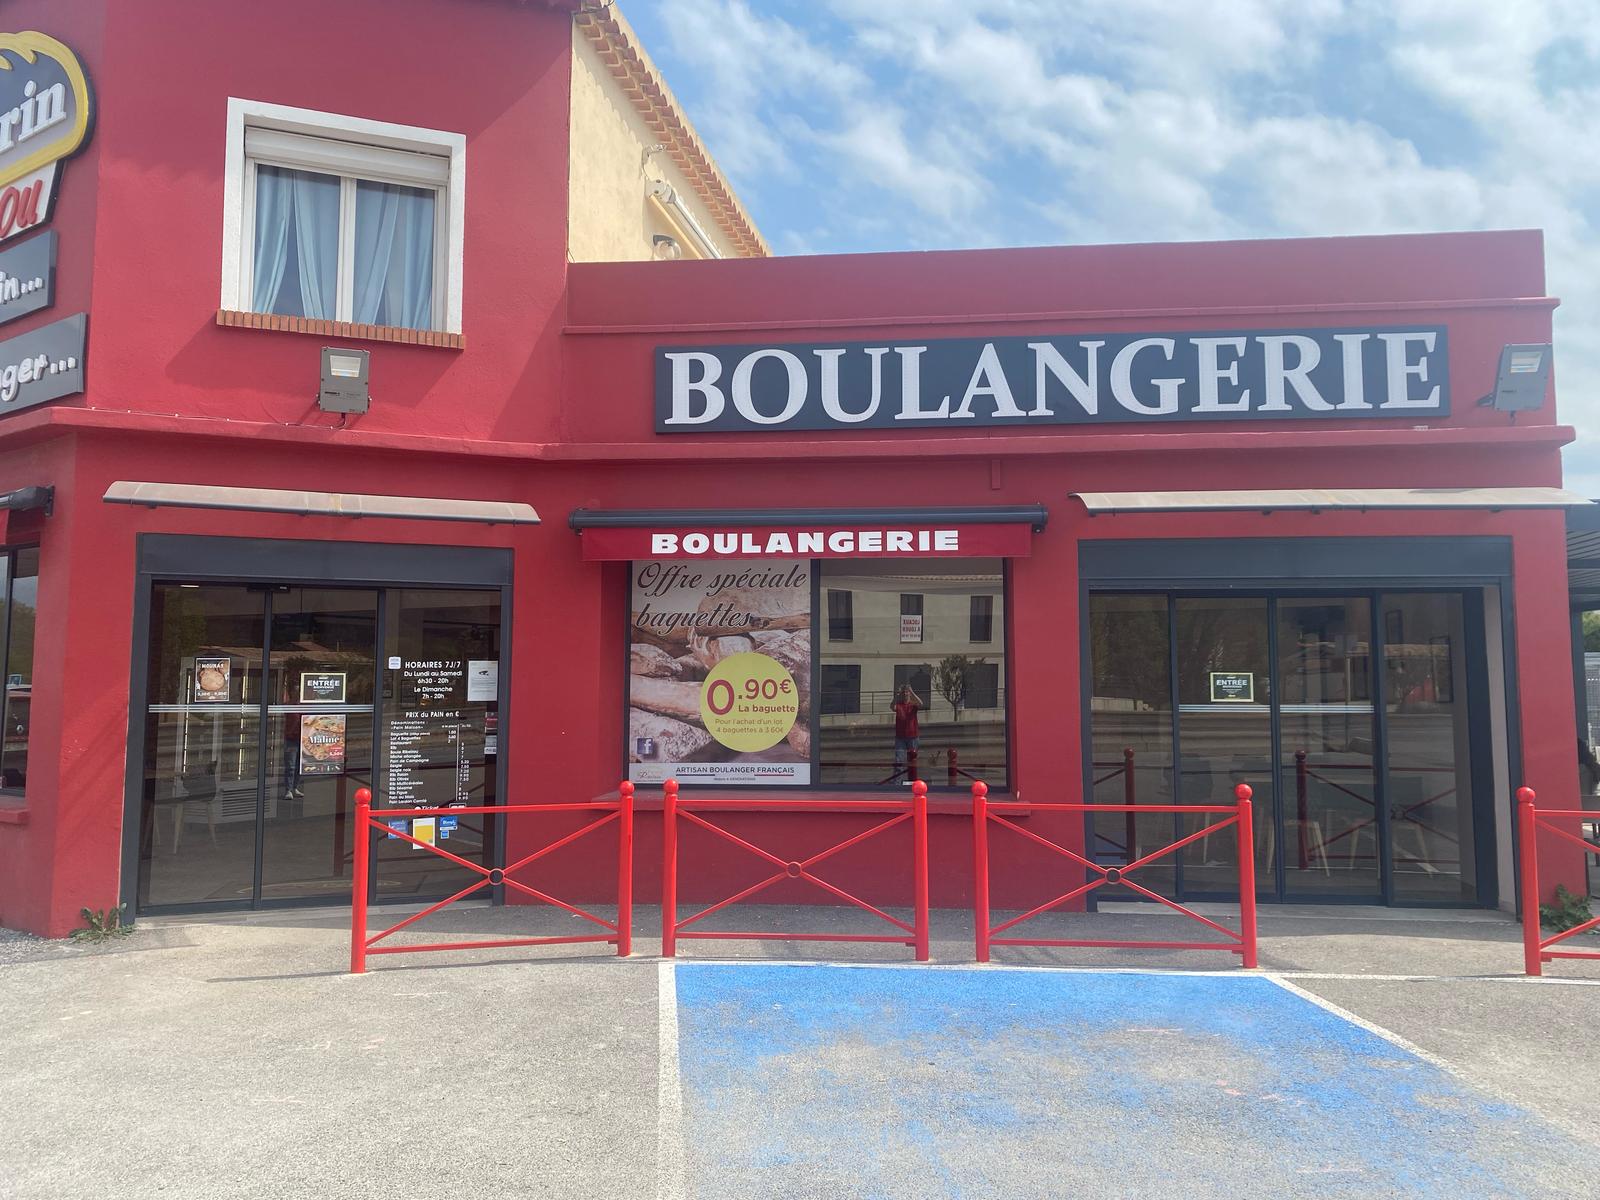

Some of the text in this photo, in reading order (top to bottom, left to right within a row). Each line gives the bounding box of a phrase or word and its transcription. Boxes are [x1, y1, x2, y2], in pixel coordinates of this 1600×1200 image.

[0, 80, 66, 151] rin
[0, 354, 76, 401] ger...
[664, 331, 1441, 424] BOULANGERIE
[652, 530, 959, 554] BOULANGERIE
[637, 562, 807, 597] Offre spéciale
[635, 602, 751, 636] baguettes
[445, 661, 461, 669] 7J/7
[307, 678, 340, 687] ENTRÉE
[1216, 678, 1248, 686] ENTRÉE
[738, 704, 796, 714] La baguette
[722, 726, 757, 734] baguettes
[756, 766, 795, 775] FRANÇAIS
